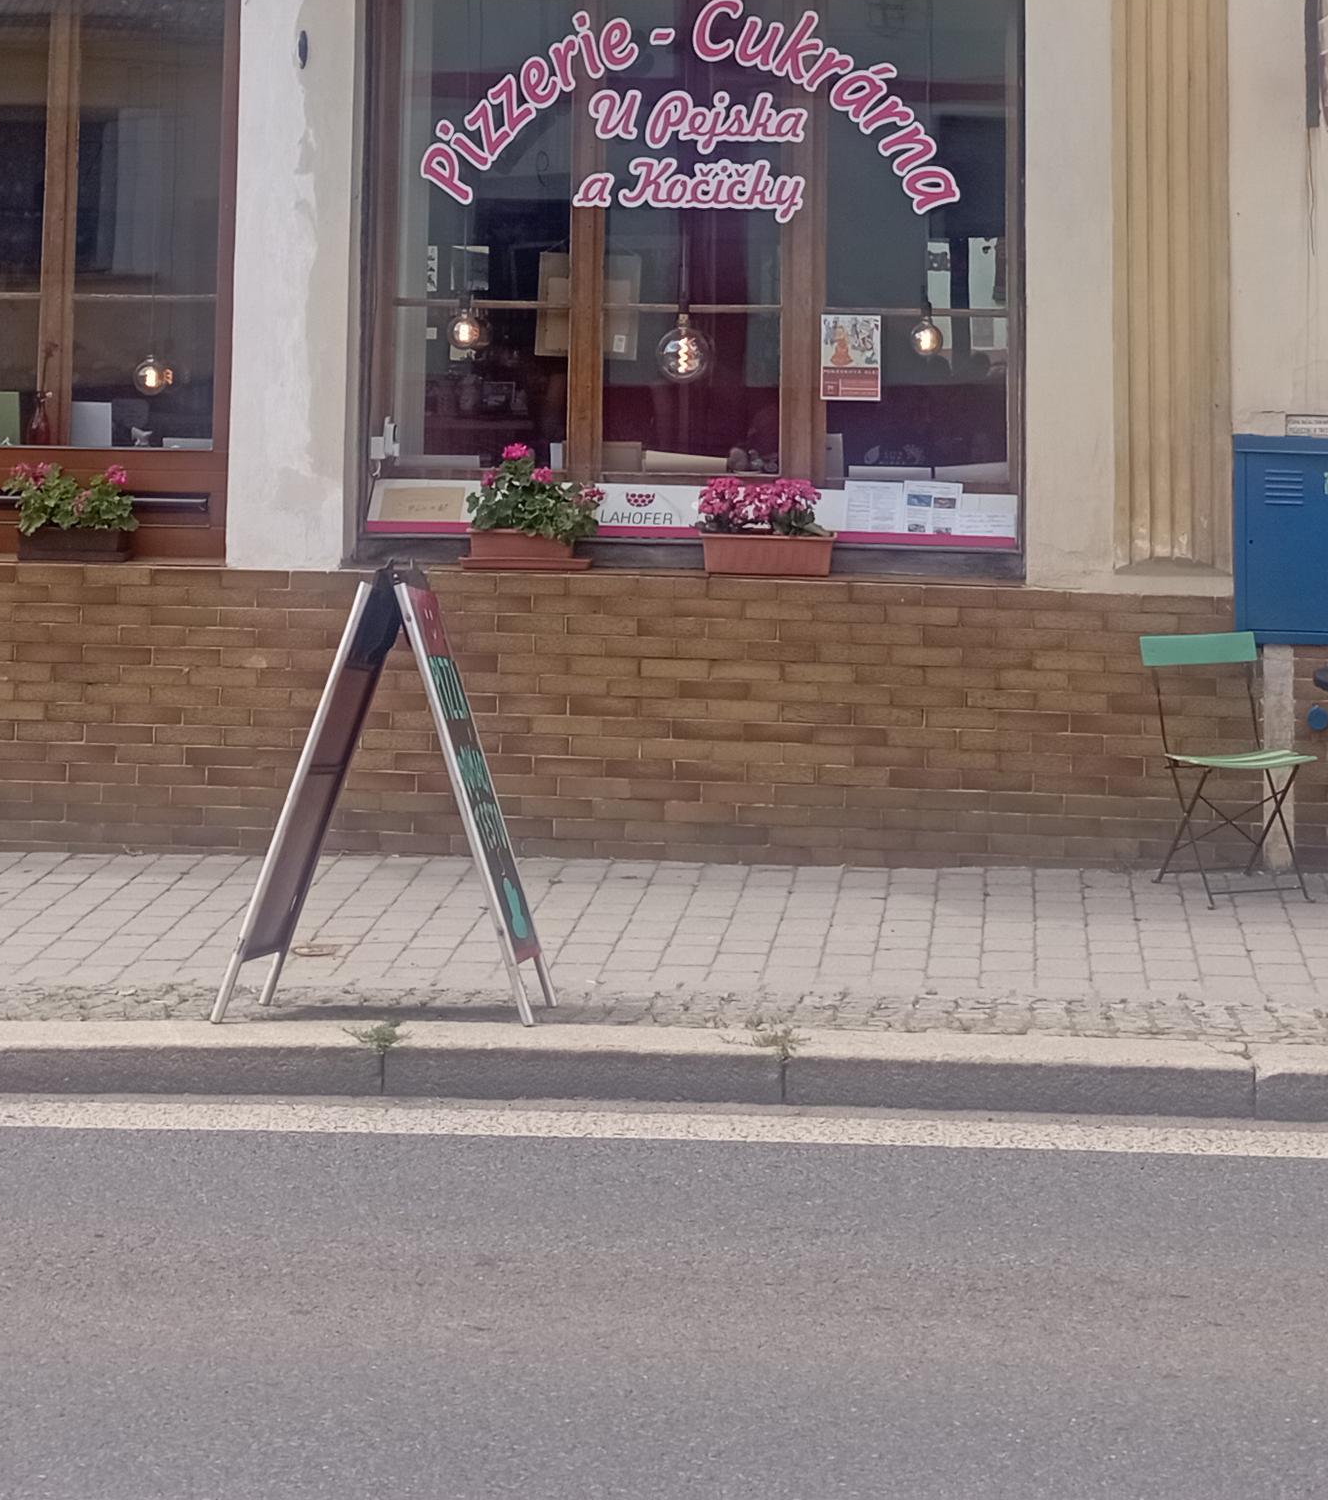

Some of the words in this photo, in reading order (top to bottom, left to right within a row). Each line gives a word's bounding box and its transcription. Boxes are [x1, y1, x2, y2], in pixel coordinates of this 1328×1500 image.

[421, 10, 639, 205] Pizzerie
[589, 89, 642, 140] U
[645, 91, 808, 154] Pejska
[572, 172, 615, 207] a
[618, 157, 805, 223] Kočičky
[599, 509, 673, 525] LAHOFER
[427, 655, 470, 721] PIZZA
